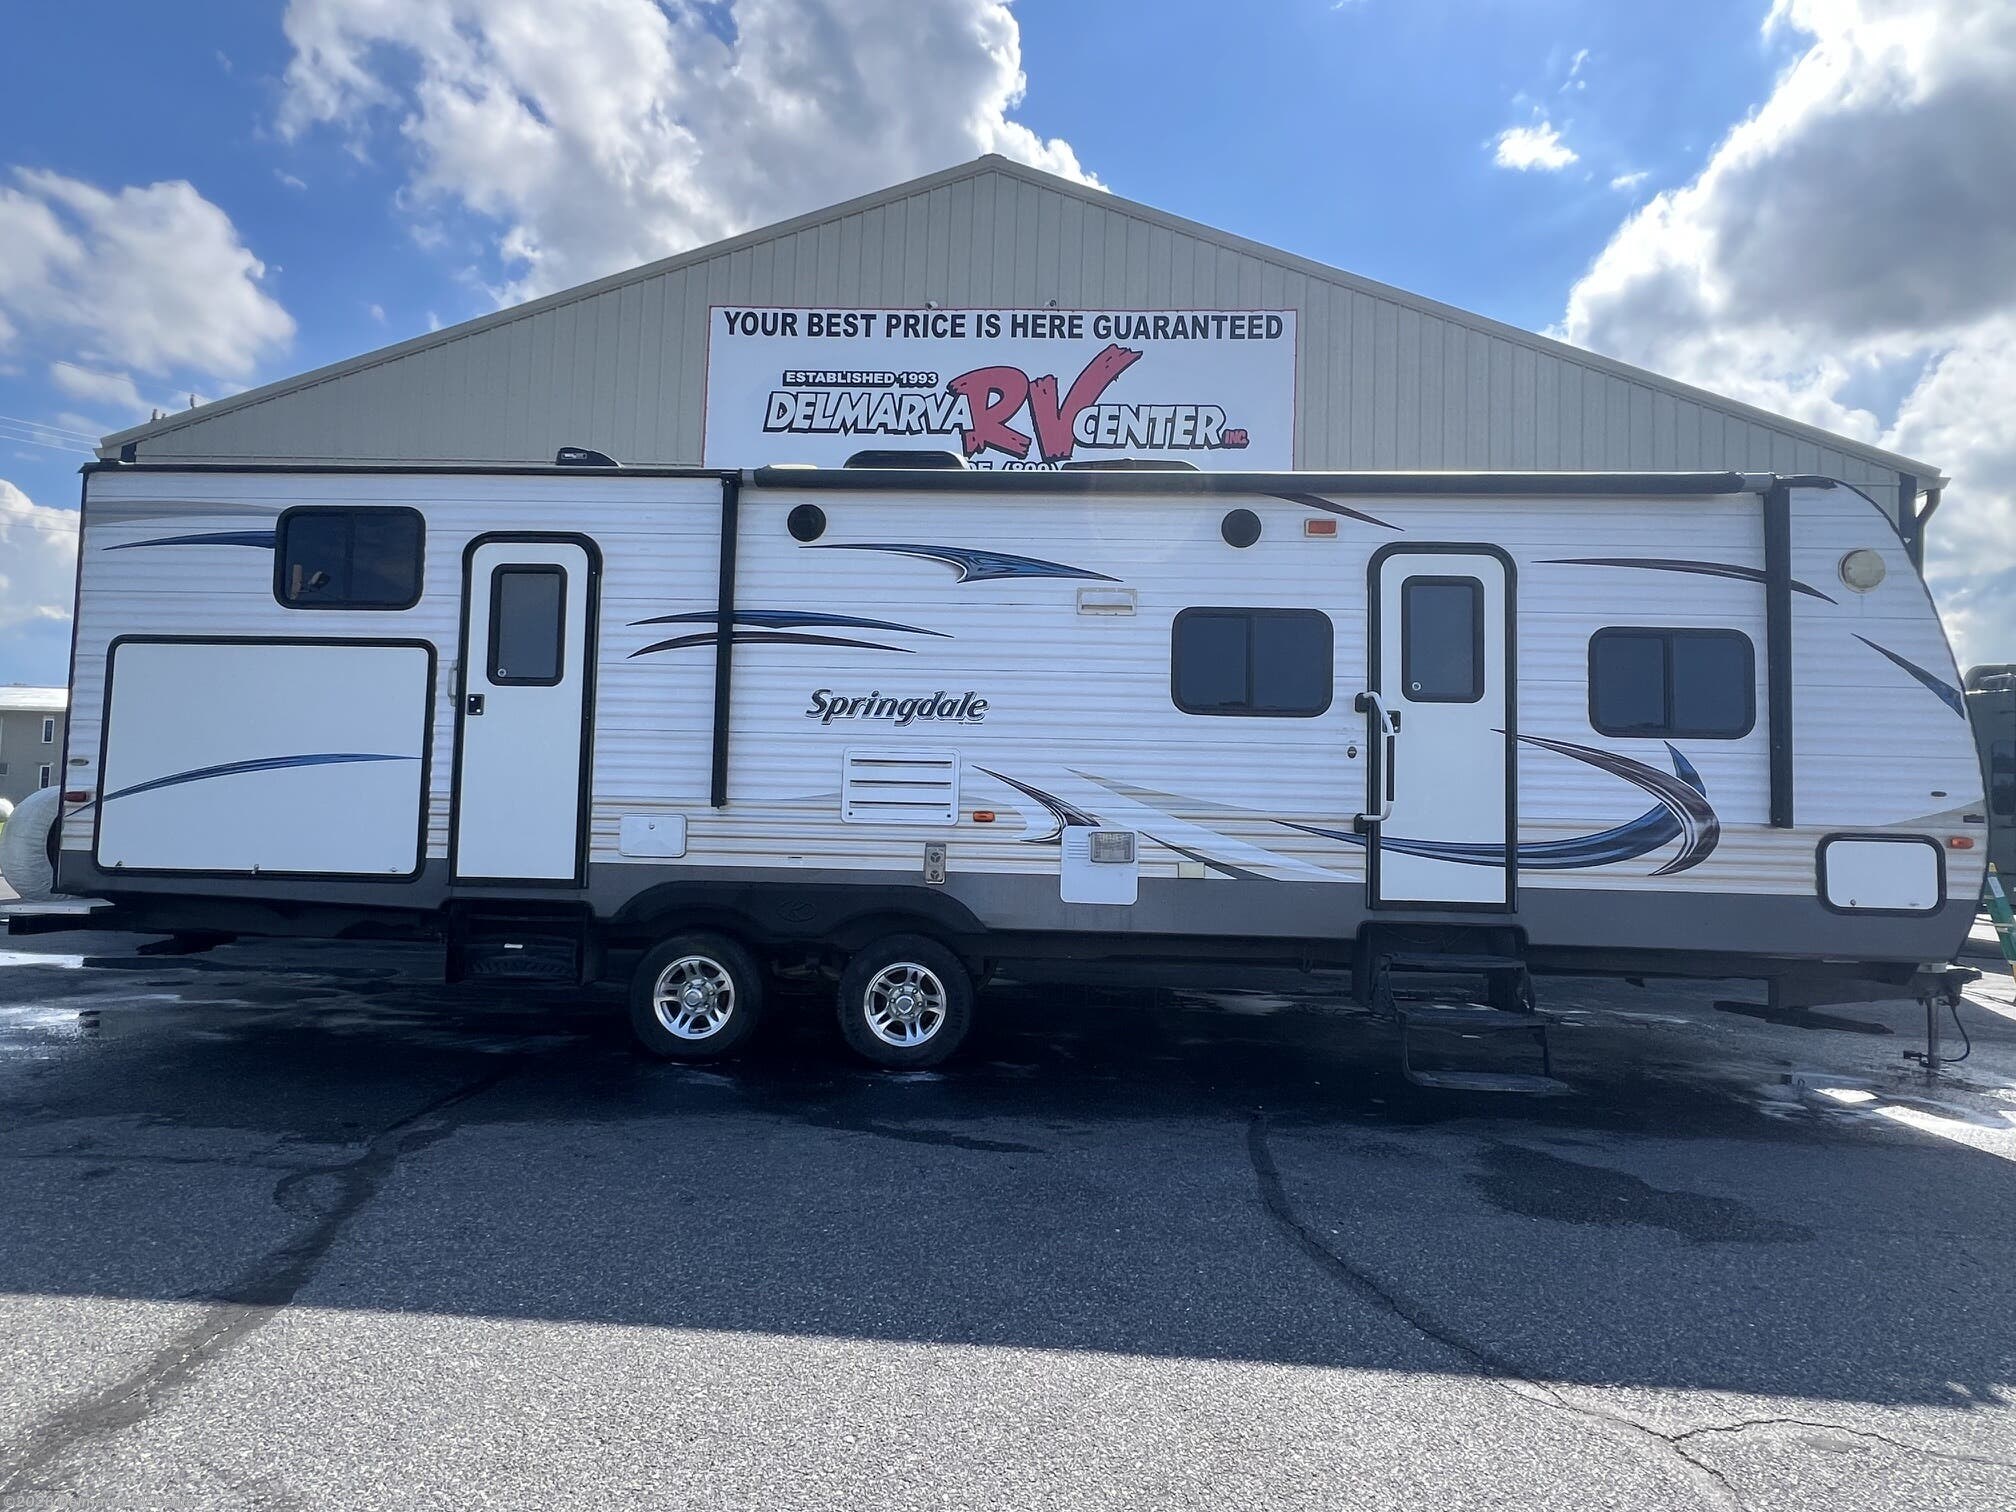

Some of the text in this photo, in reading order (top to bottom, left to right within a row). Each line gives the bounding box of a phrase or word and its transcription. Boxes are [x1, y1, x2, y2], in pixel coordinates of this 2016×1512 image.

[724, 311, 1283, 340] YOUR BEST PRICE IS HERE GUARANTEED
[785, 371, 939, 386] ESTABLISHED 1993
[763, 391, 975, 436] DELMARVA
[946, 343, 1143, 461] RV
[1072, 404, 1226, 449] CENTER
[805, 688, 990, 727] Springdale
